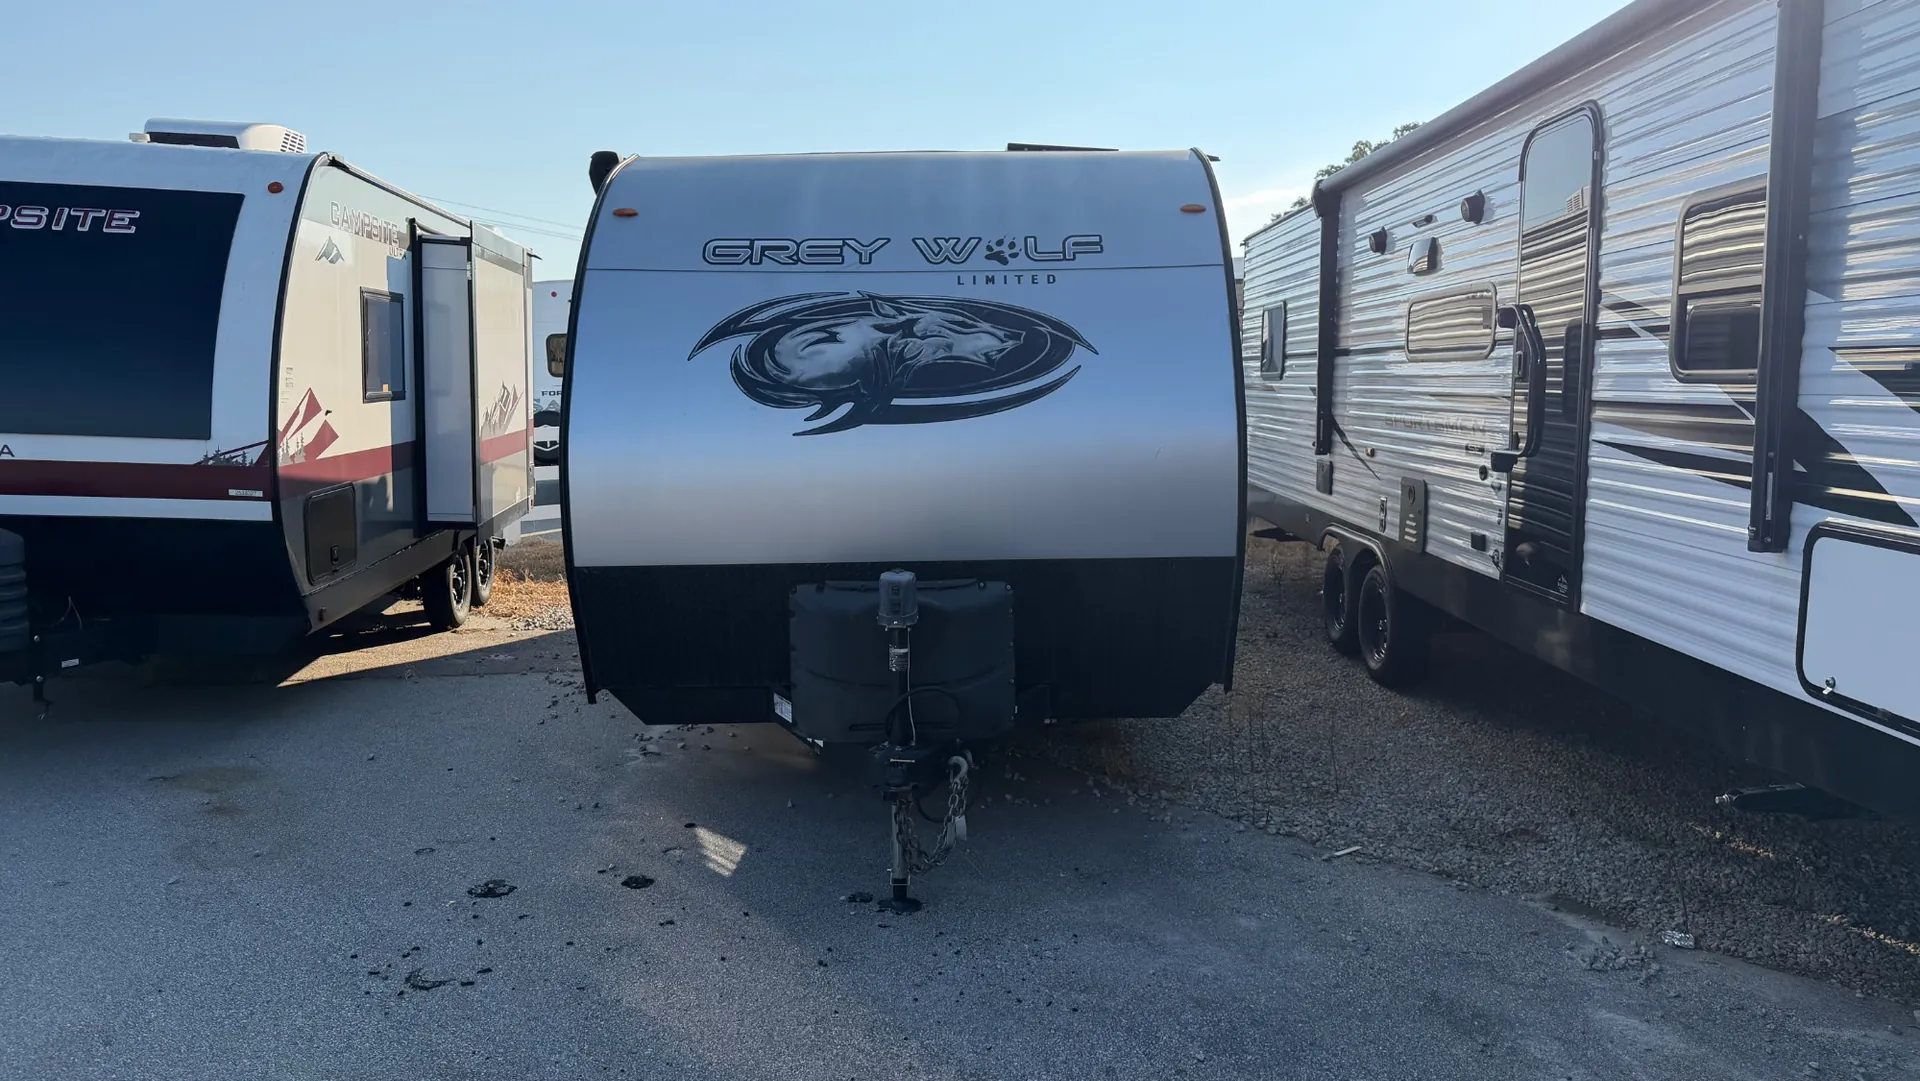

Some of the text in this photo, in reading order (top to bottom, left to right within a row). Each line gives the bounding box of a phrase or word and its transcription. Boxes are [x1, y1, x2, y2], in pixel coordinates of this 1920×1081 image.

[330, 200, 400, 247] CAMPSITE
[702, 237, 891, 266] GREY
[957, 274, 1057, 286] LIMITED
